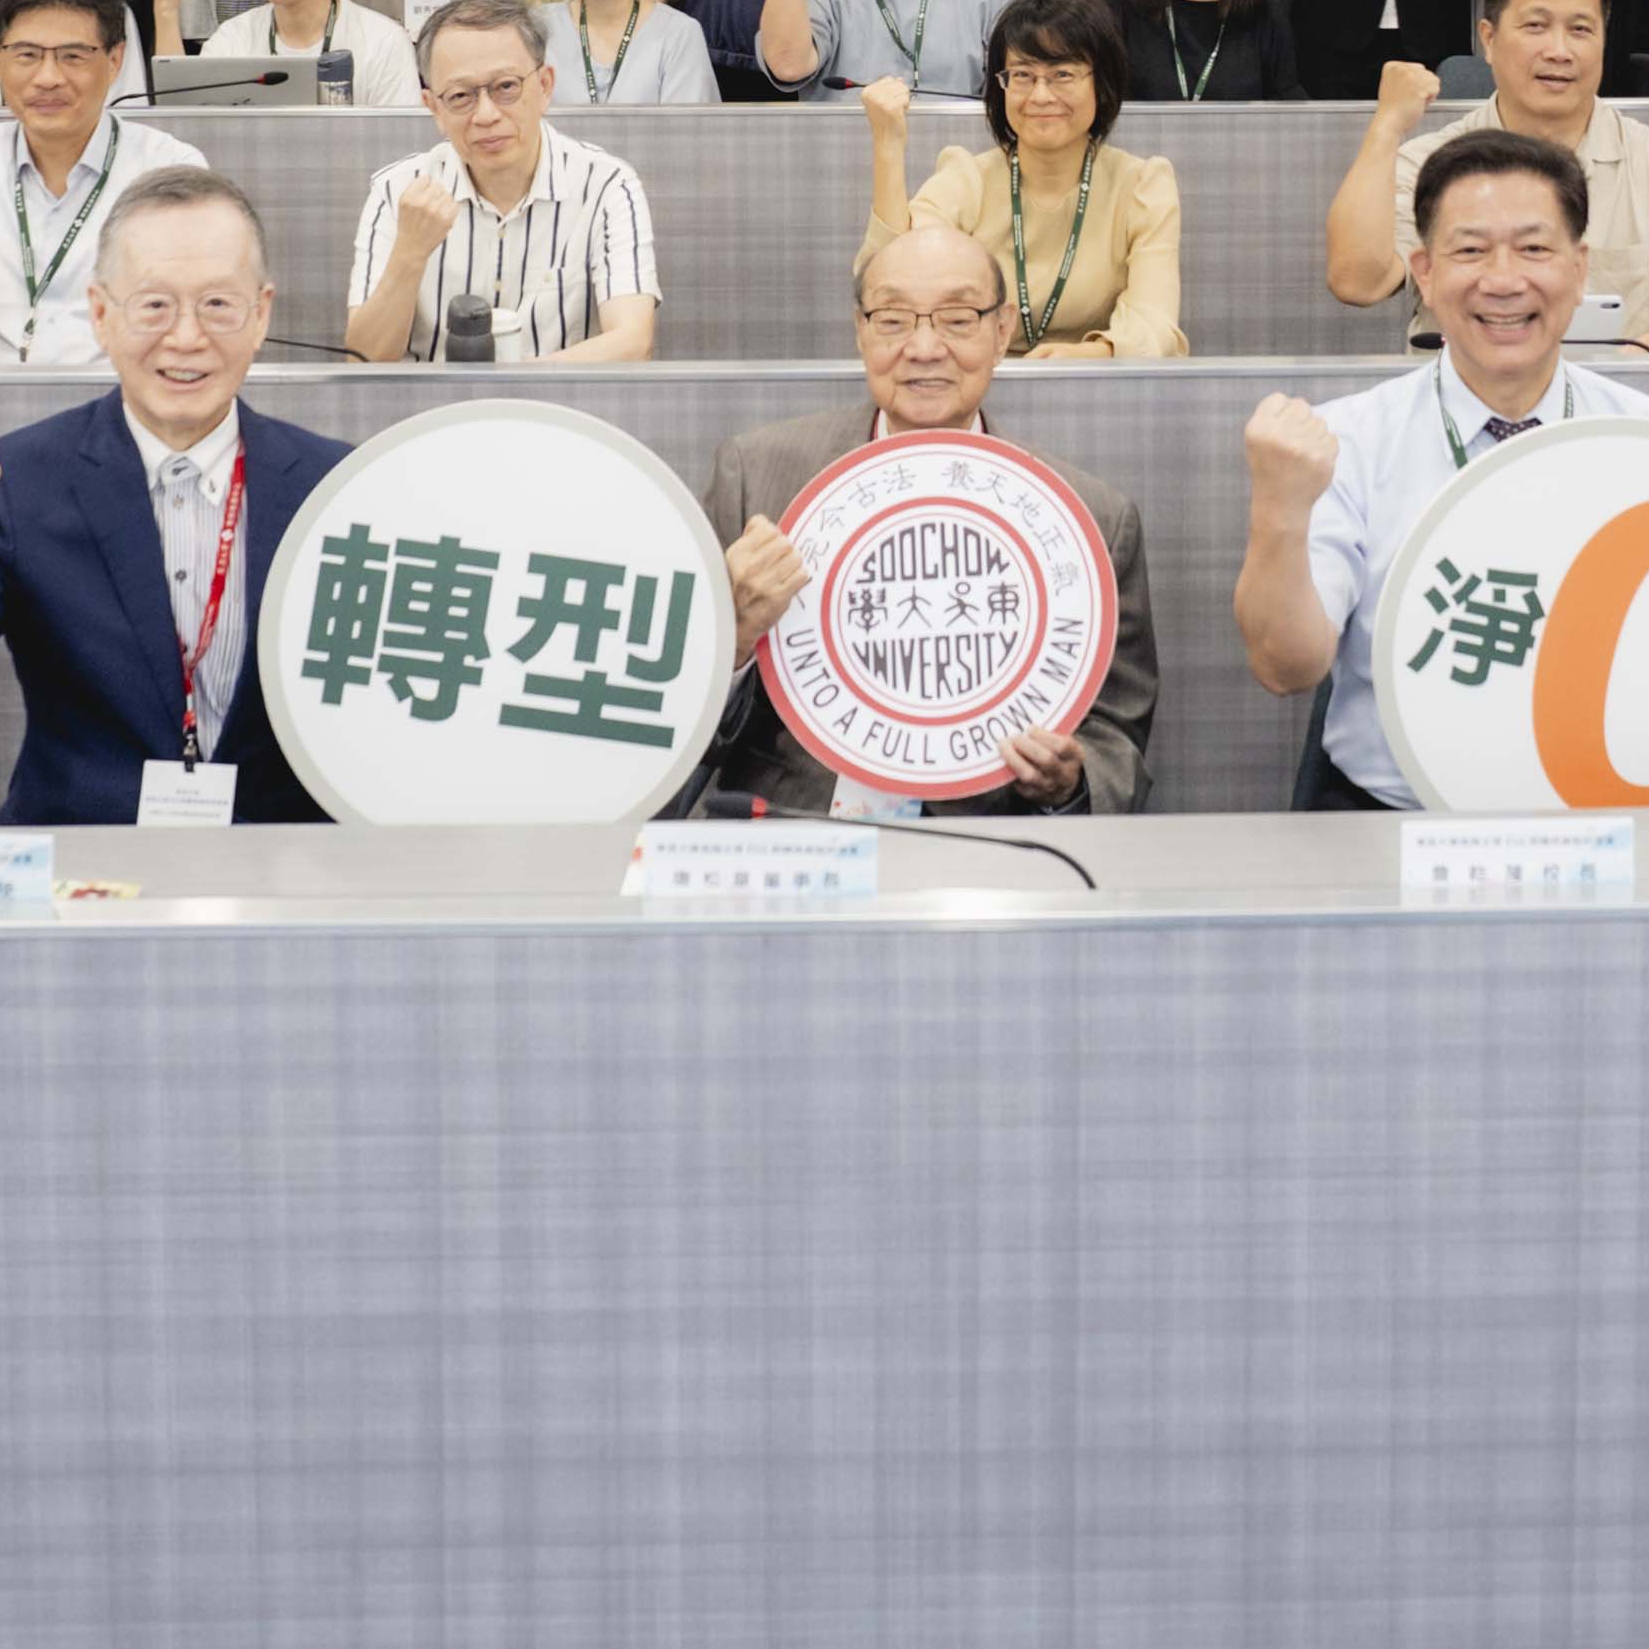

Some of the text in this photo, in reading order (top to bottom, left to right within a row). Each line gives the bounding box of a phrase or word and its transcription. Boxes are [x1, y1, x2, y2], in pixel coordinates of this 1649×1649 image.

[855, 521, 1011, 584] SOOCHOW
[300, 521, 697, 749] 轉型
[786, 615, 1085, 765] UNTO A FULL GROWN MAN
[851, 630, 1019, 700] UNIVERSITY
